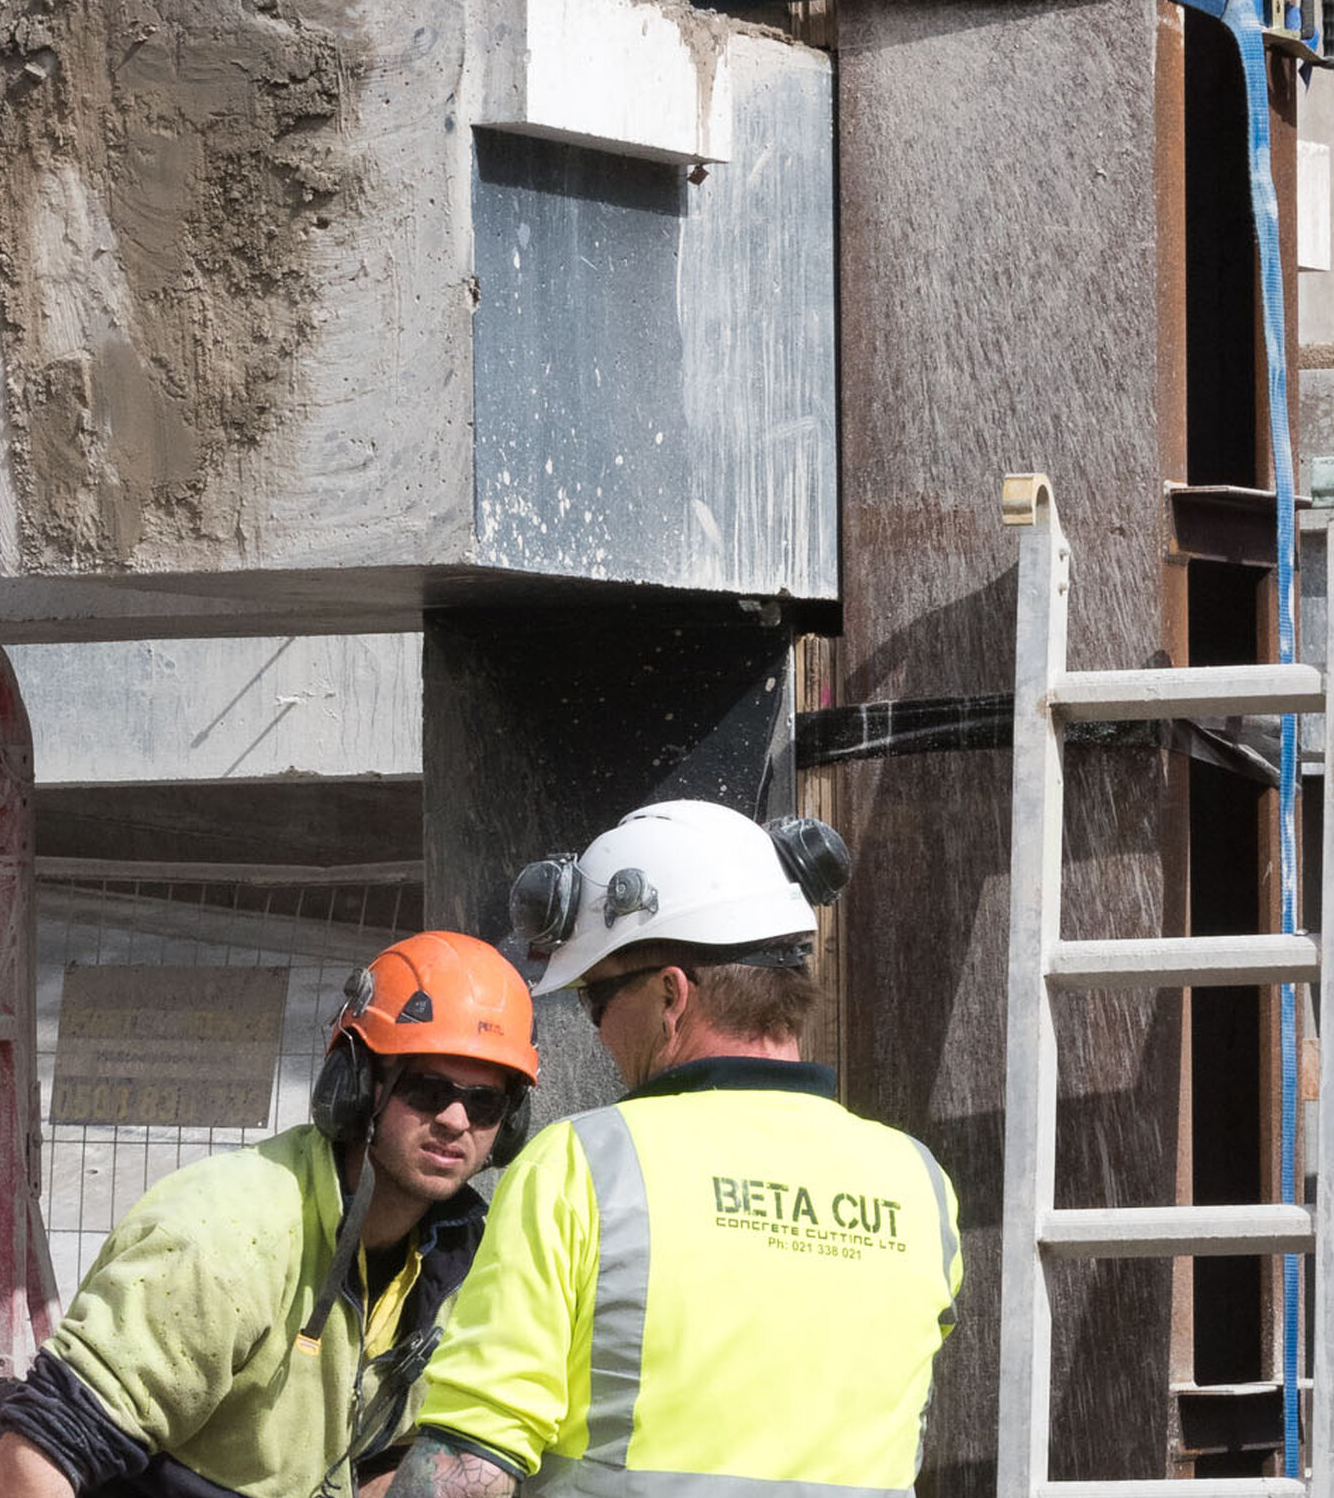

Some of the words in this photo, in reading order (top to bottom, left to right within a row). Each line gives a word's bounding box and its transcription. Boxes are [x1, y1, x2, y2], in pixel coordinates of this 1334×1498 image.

[712, 1176, 819, 1225] BETA
[832, 1192, 901, 1237] CUT
[716, 1217, 800, 1236] CONCRETE
[805, 1228, 873, 1247] CUTTING
[879, 1239, 907, 1253] LTD
[768, 1236, 788, 1250] Ph:
[792, 1239, 812, 1253] 021
[817, 1243, 839, 1257] 338
[841, 1246, 862, 1260] 021
